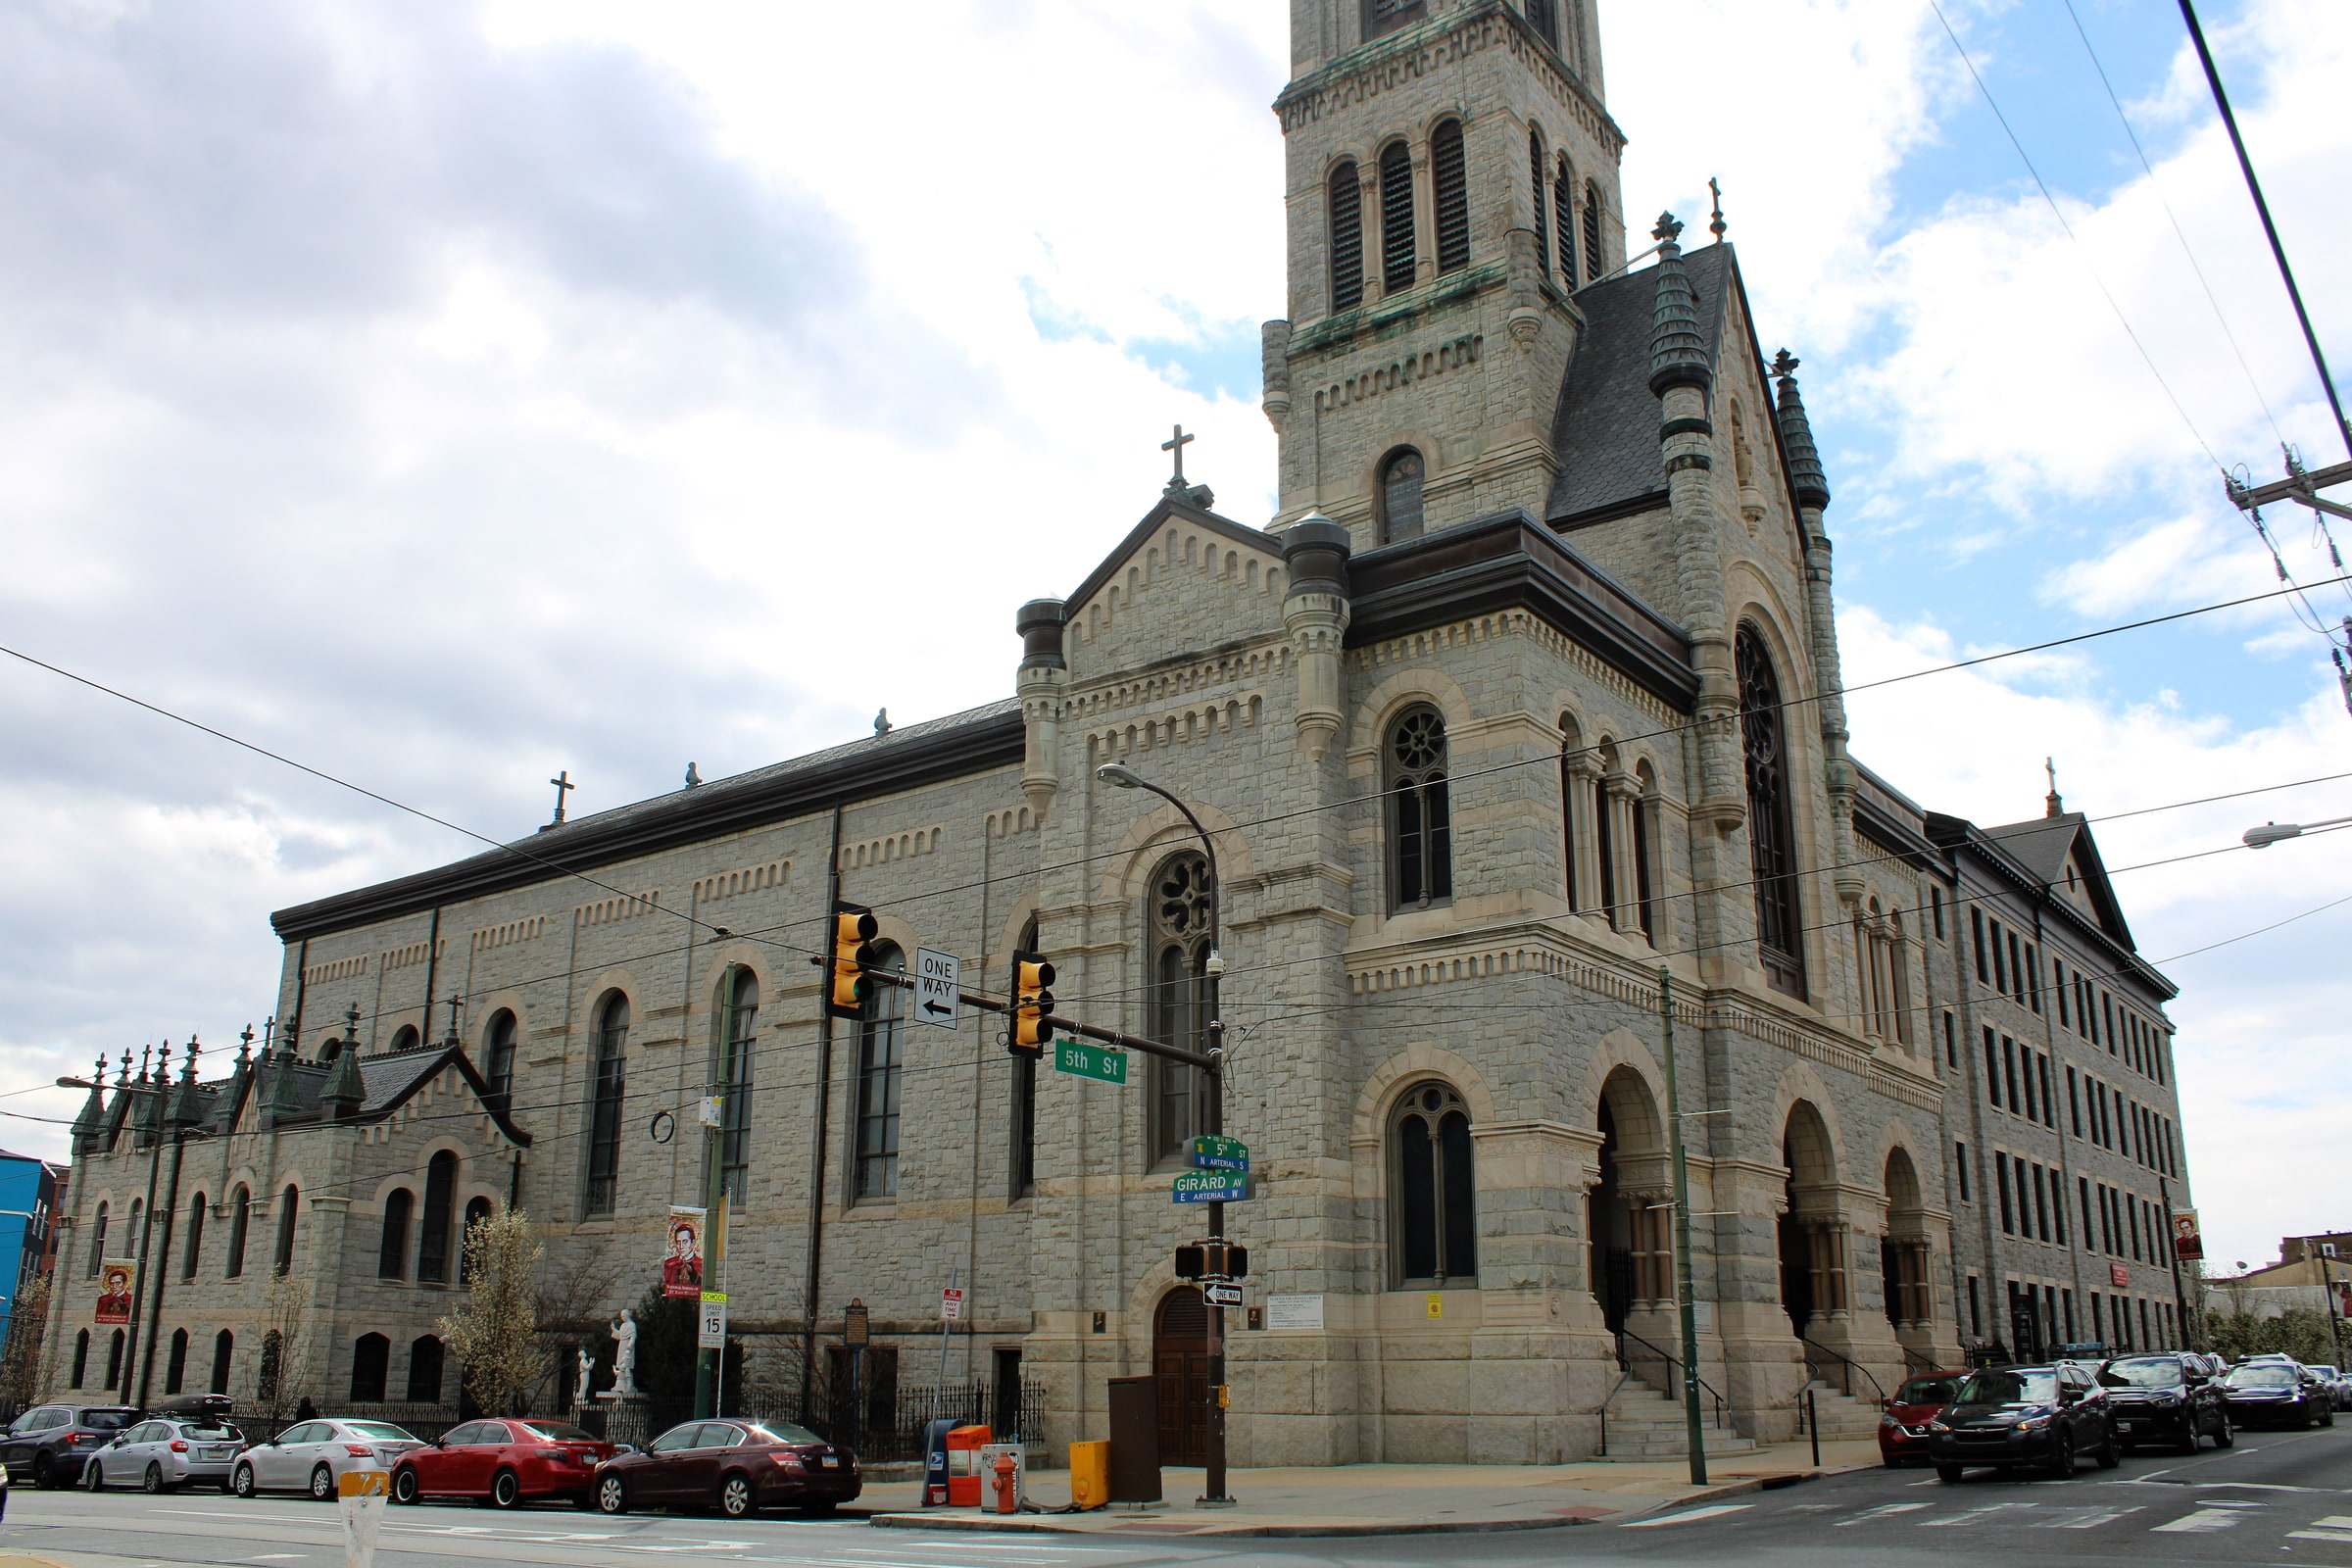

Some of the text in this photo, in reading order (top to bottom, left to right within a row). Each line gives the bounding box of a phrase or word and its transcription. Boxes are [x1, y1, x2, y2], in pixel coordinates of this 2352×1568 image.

[925, 957, 952, 978] ONE
[923, 977, 953, 997] WAY
[1065, 1050, 1118, 1075] 5th St
[1239, 1150, 1246, 1158] ST
[1200, 1156, 1245, 1170] N ARTERIAL S
[1177, 1176, 1243, 1192] GIRARD AV
[1180, 1189, 1239, 1201] E ARTERIAL W
[702, 1293, 726, 1301] SCHOOL
[1216, 1290, 1227, 1299] ONE
[706, 1318, 720, 1333] 15
